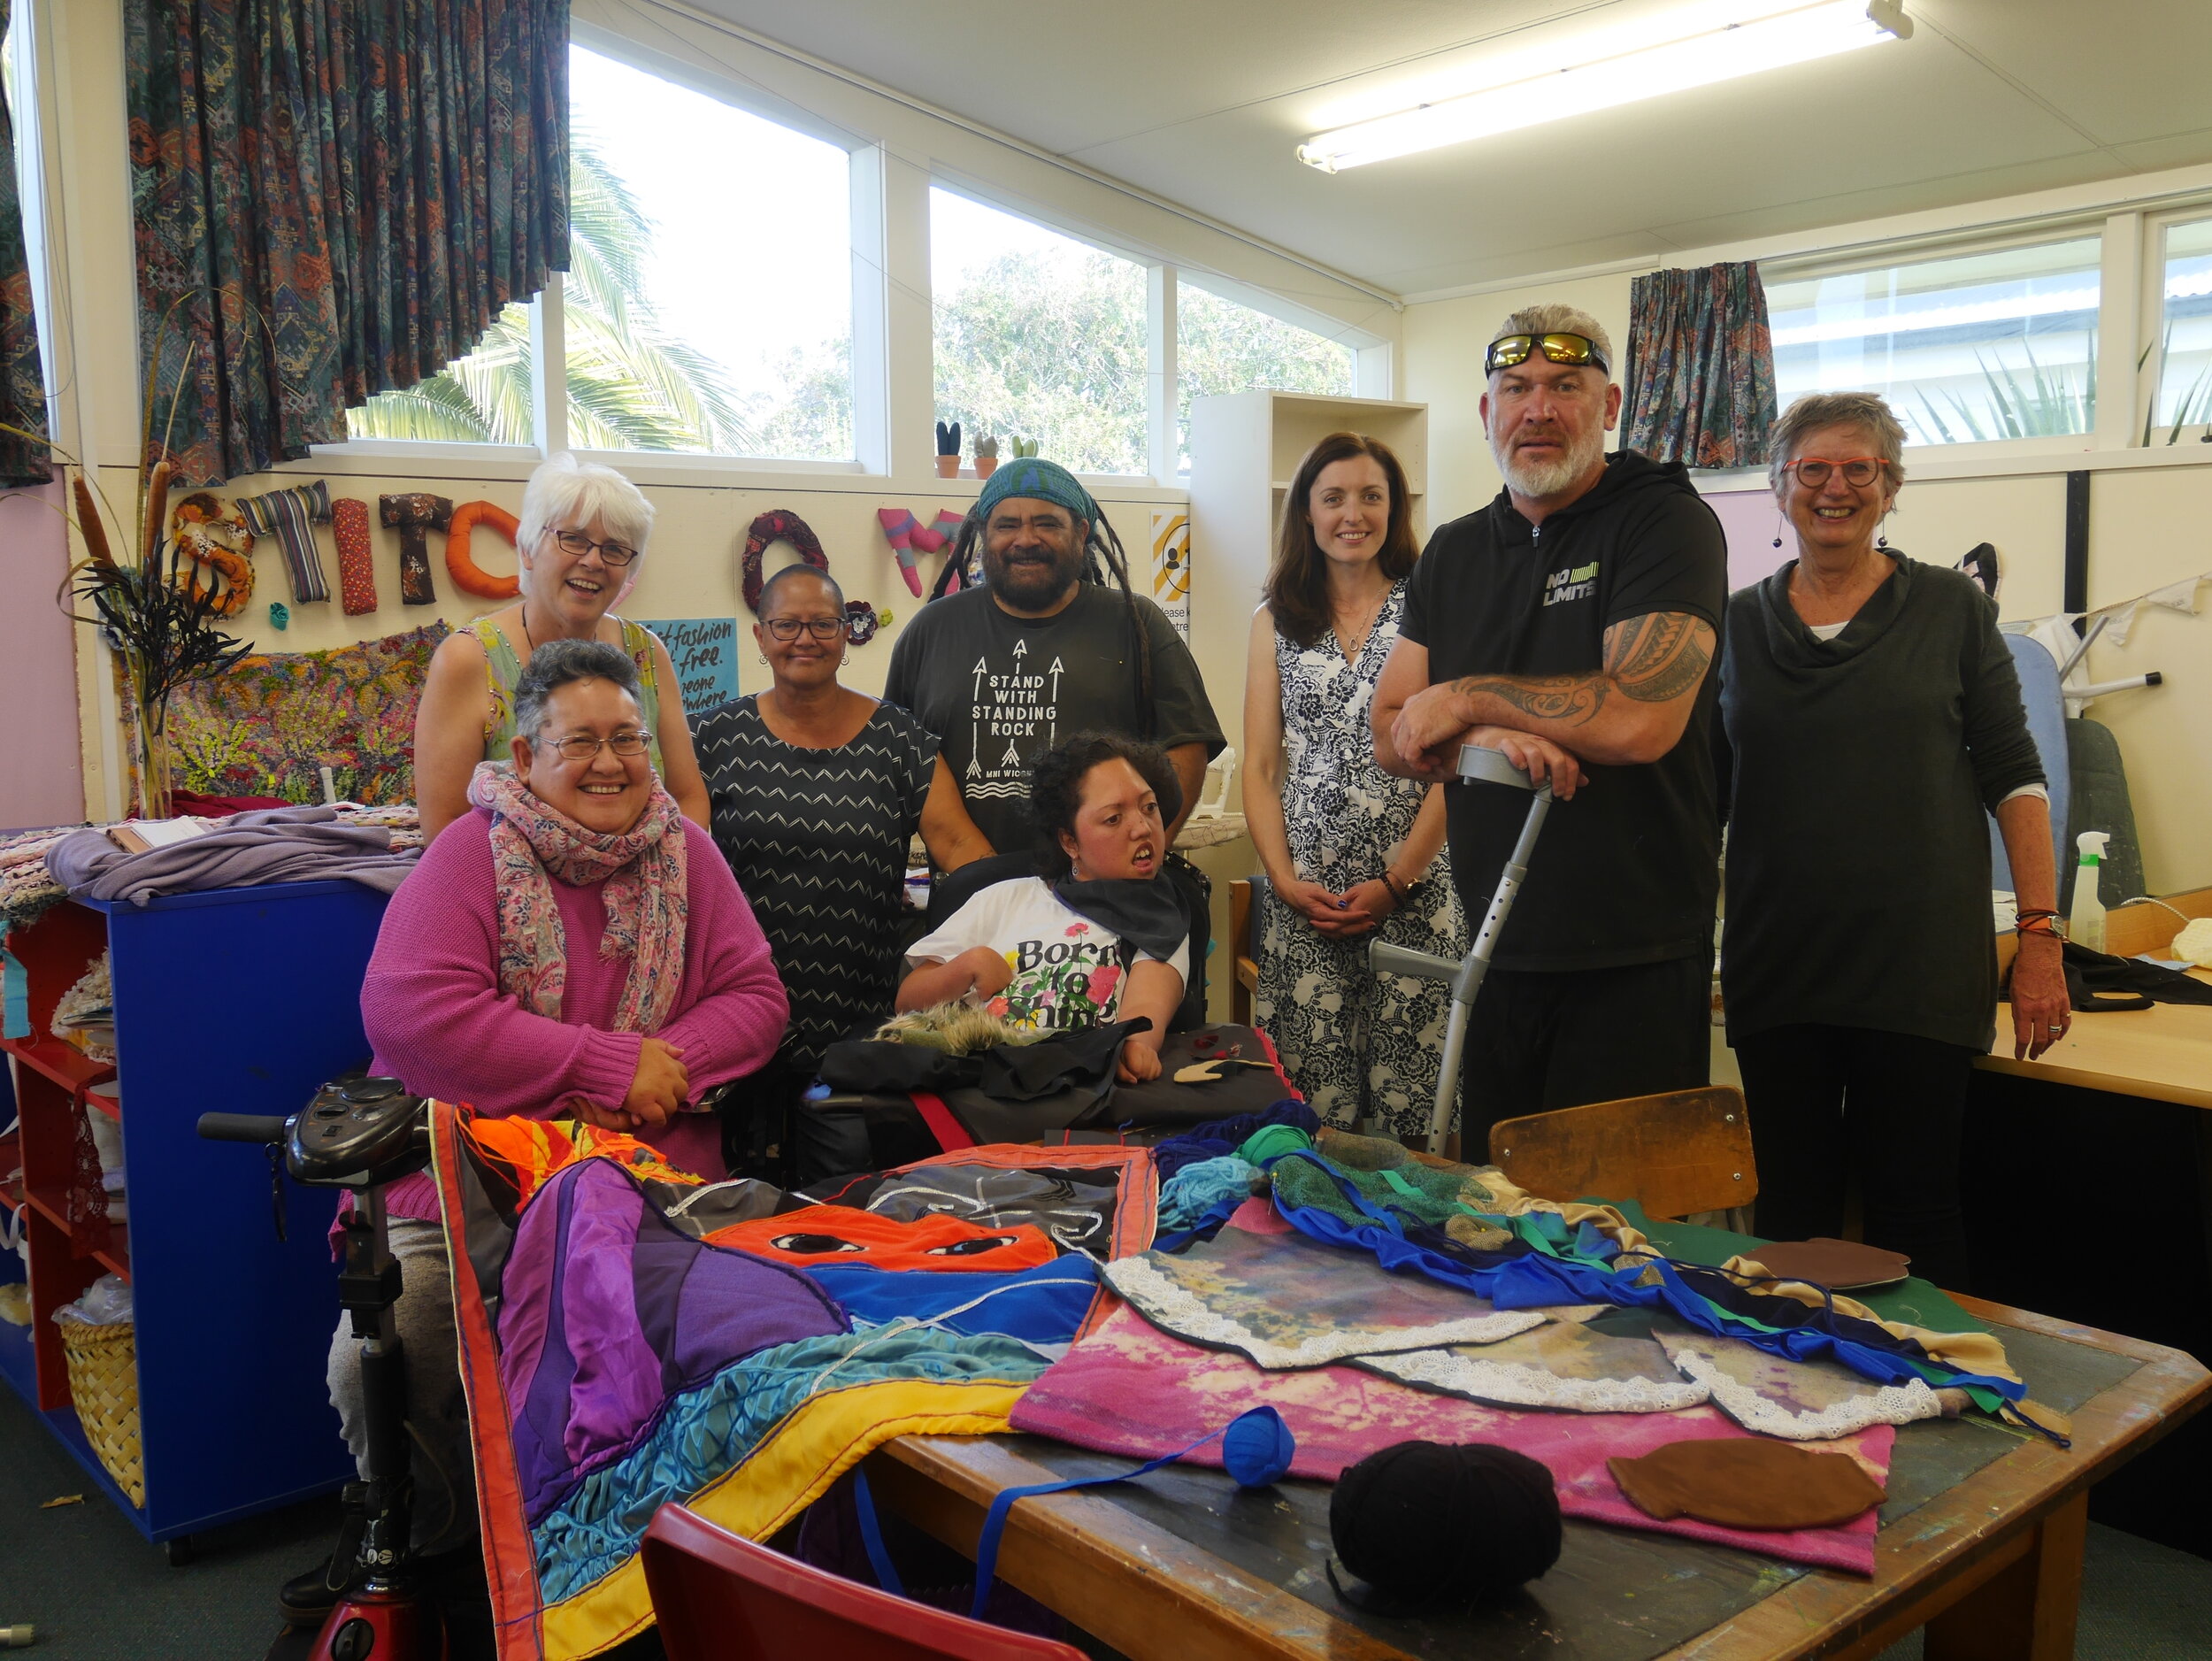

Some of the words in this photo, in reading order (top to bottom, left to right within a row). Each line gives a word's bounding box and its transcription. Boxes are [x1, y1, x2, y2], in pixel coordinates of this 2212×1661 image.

[171, 479, 637, 625] STITC
[1546, 568, 1571, 589] NO
[1543, 580, 1597, 607] LIMITS
[1161, 607, 1185, 618] ease
[673, 622, 732, 650] fashion
[679, 646, 723, 677] free.
[989, 675, 1044, 688] STAND
[995, 690, 1037, 704] WITH
[972, 705, 1056, 720] STANDING
[991, 722, 1034, 736] ROCK
[1017, 940, 1121, 974] Born
[1049, 965, 1092, 996] to
